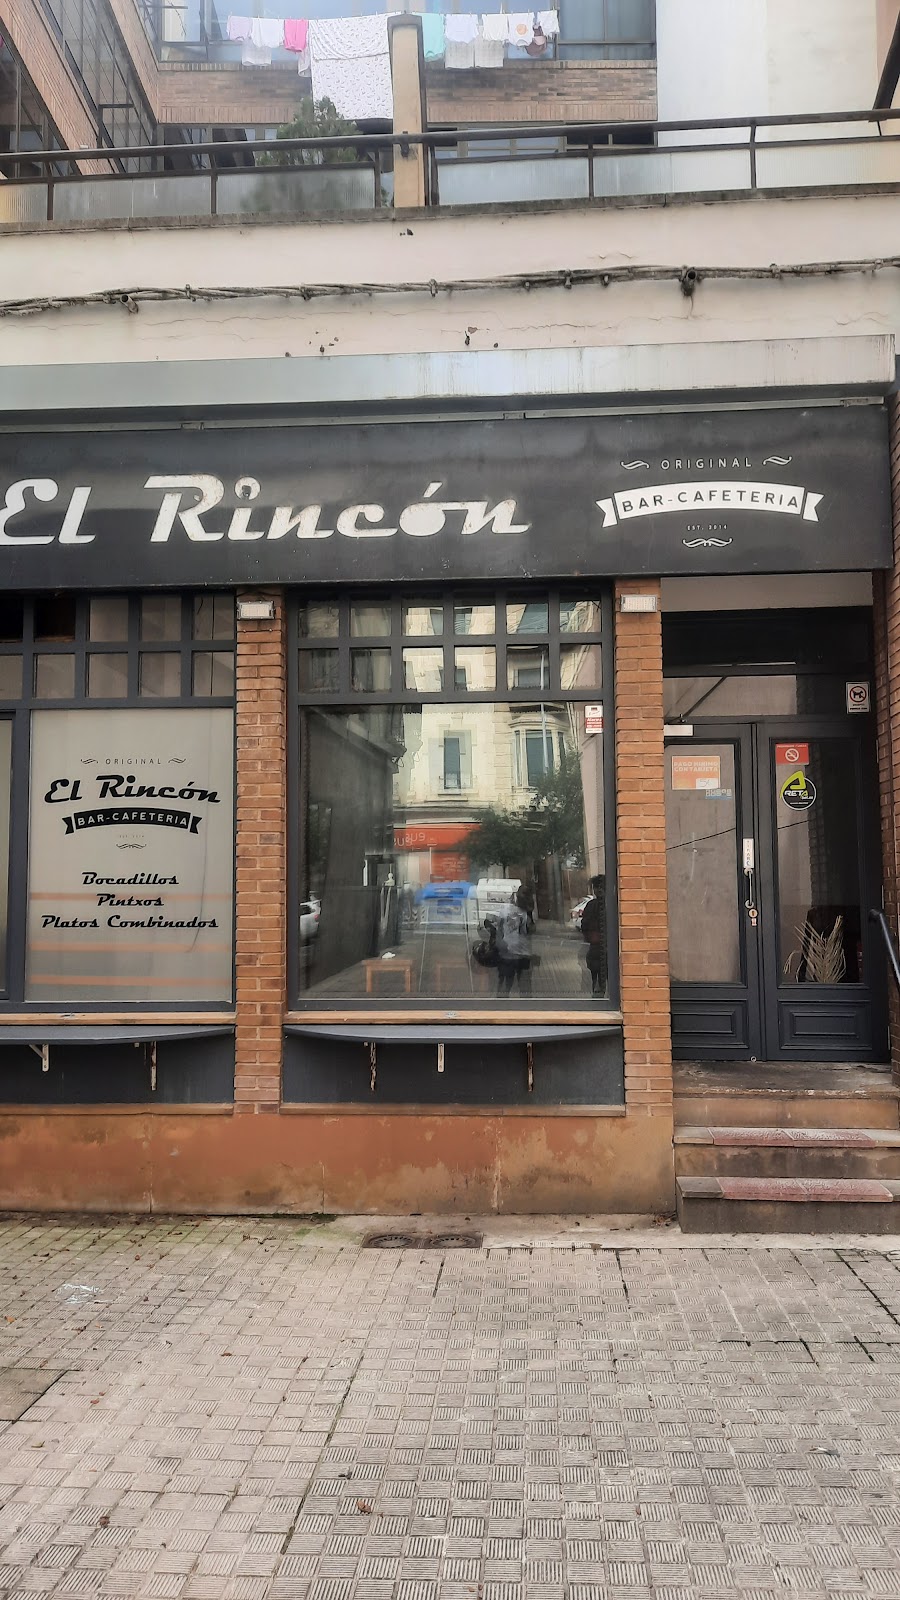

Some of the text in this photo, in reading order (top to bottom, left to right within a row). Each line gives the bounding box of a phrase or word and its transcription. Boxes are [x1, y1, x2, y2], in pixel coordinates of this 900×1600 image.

[660, 457, 752, 470] ORIGINAL
[622, 490, 798, 512] BAR-CAFETERIA
[0, 473, 531, 545] El Rincón
[44, 775, 221, 804] El Rincón
[78, 811, 188, 826] BAR-CAFETERIA
[82, 871, 179, 885] Bocadillos
[97, 893, 164, 906] Pintxos
[41, 914, 218, 928] Platos Combinados
